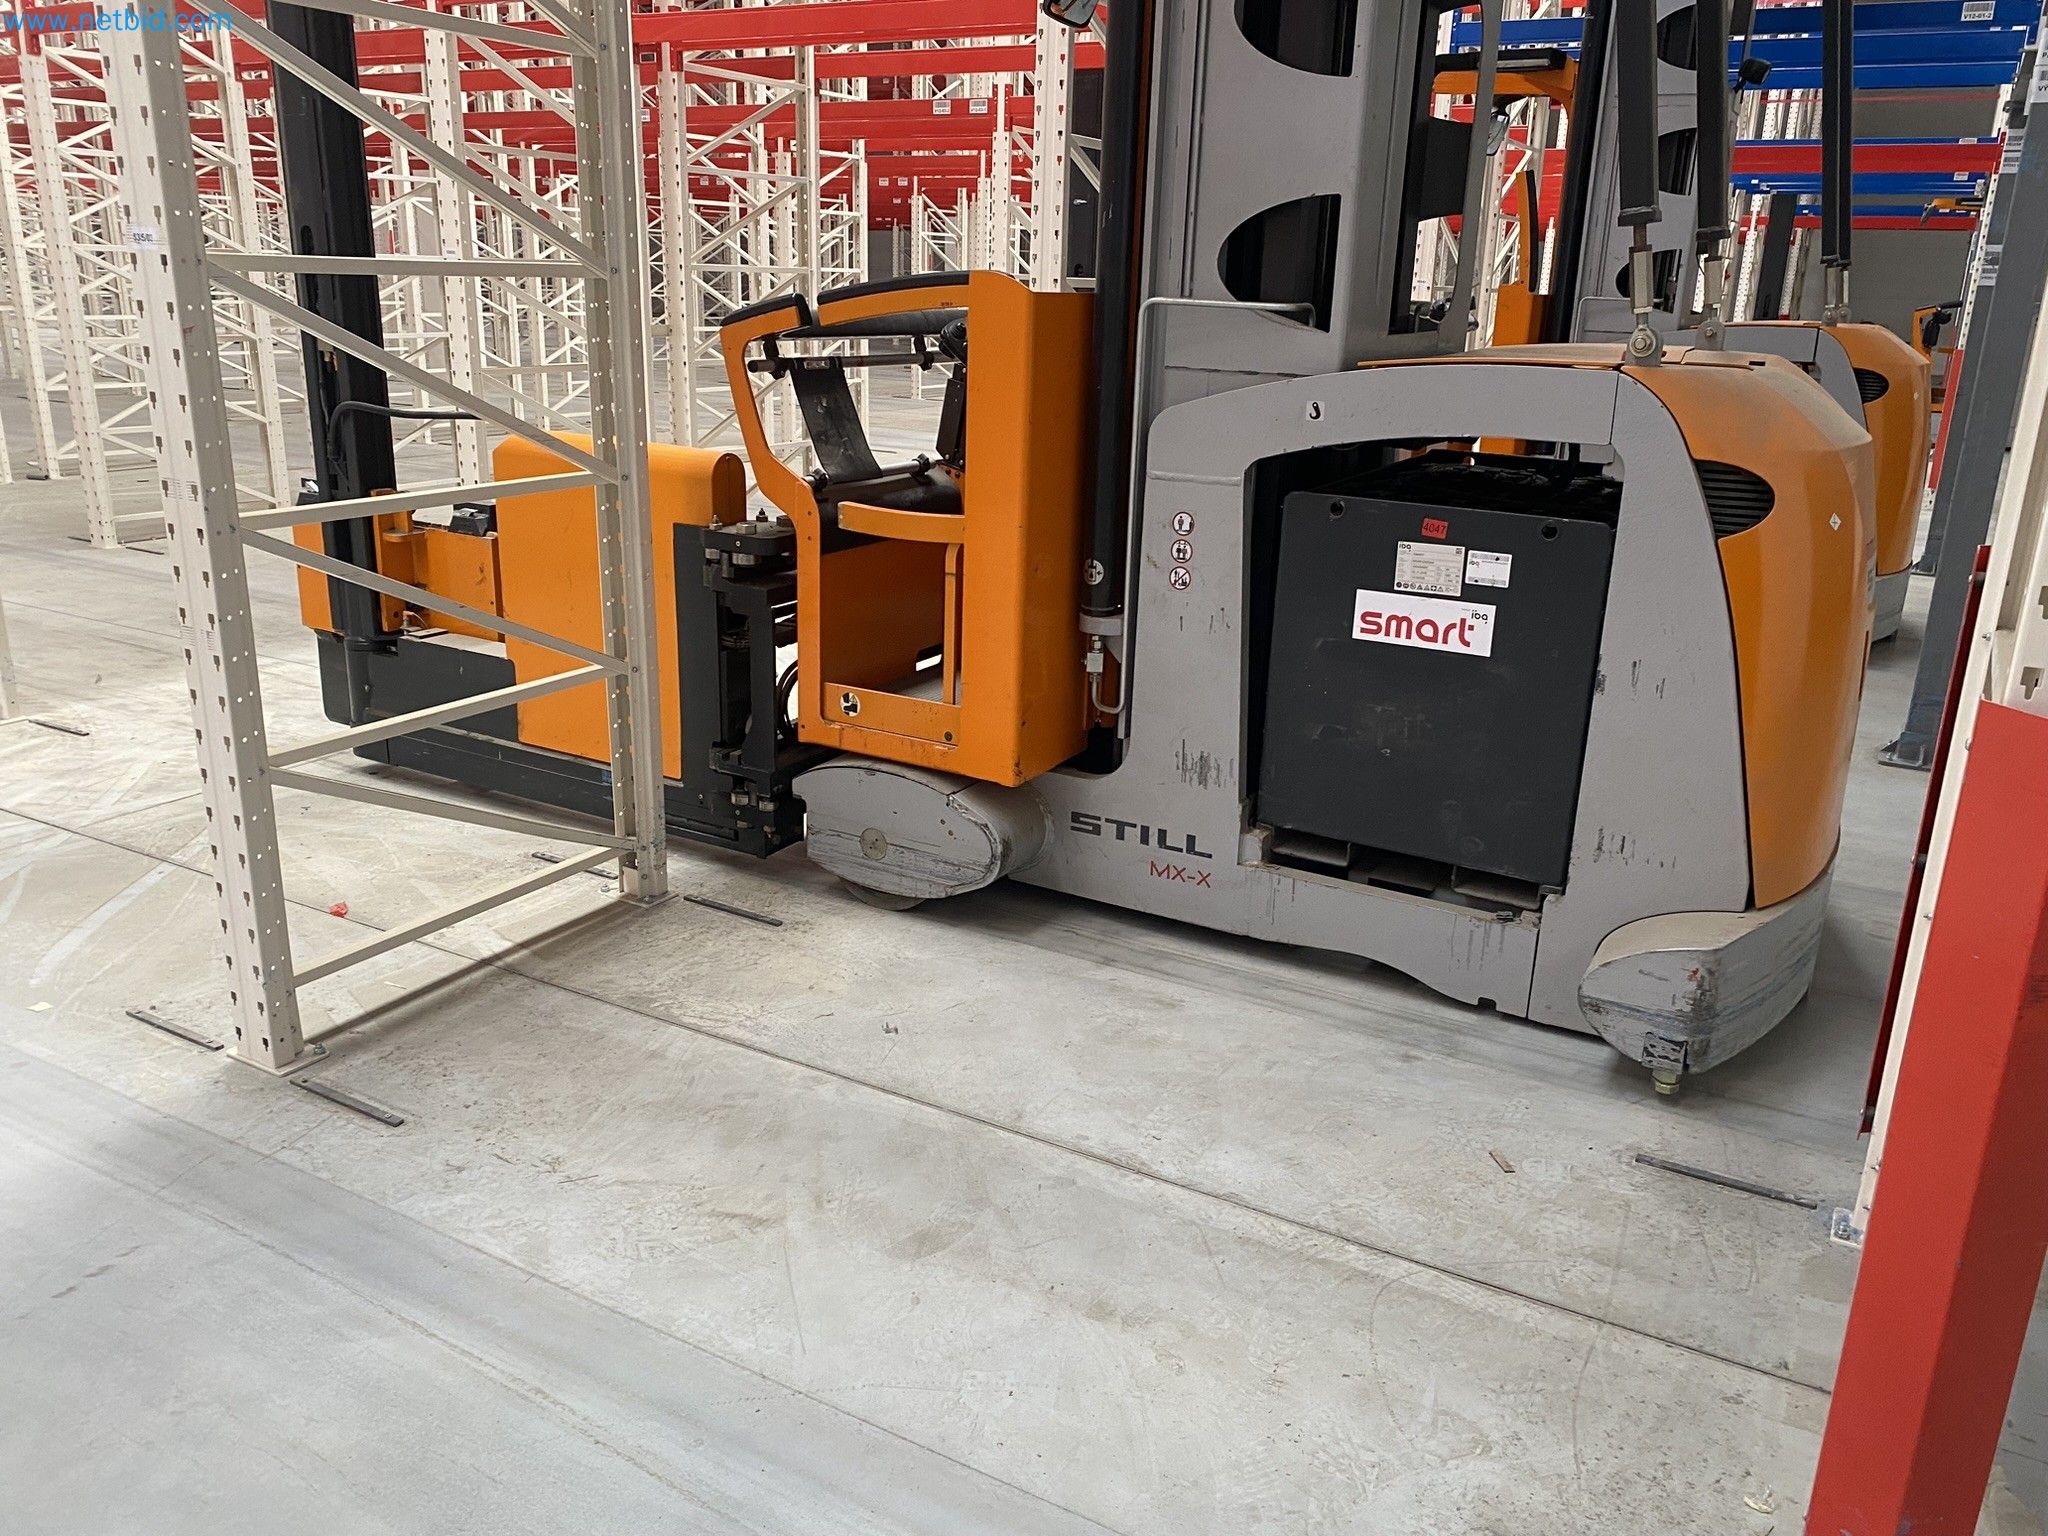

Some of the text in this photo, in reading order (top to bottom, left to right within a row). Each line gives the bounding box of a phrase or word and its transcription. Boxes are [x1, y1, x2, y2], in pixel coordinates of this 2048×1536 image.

[1423, 522, 1447, 534] 4047
[1359, 610, 1475, 648] smart
[1070, 811, 1213, 859] STILL
[1150, 860, 1212, 889] MX-X
